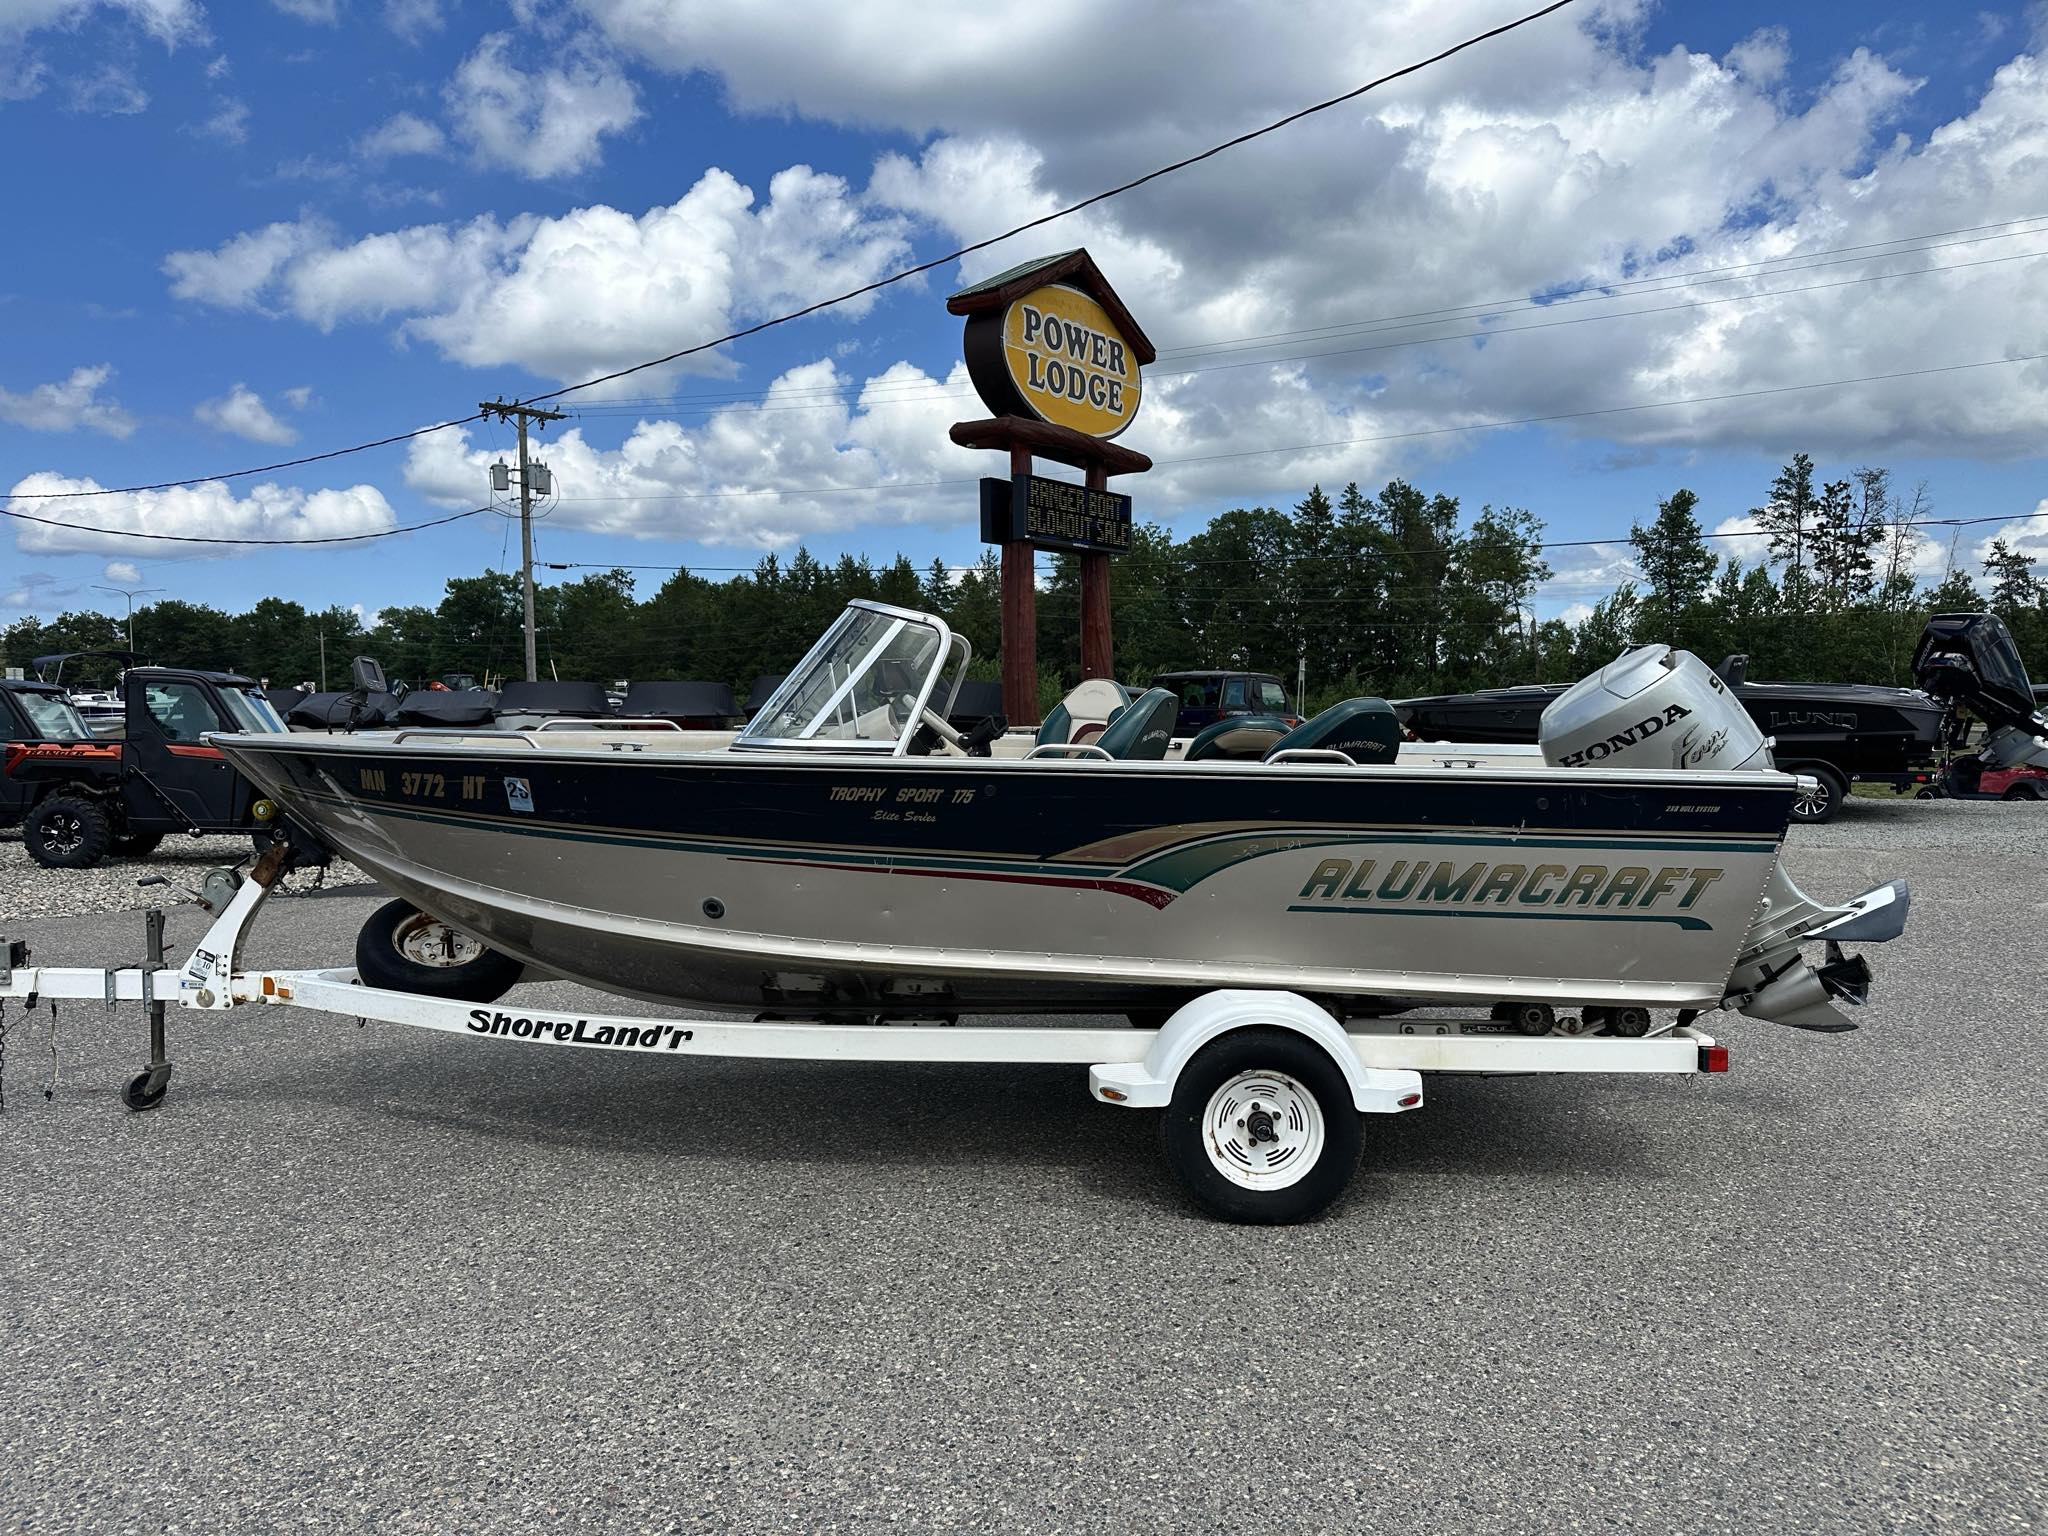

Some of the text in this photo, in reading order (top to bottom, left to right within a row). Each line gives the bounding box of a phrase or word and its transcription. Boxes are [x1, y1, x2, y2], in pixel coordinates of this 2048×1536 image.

[1023, 307, 1126, 375] POWER
[1027, 353, 1124, 413] LODGE
[1030, 479, 1123, 521] RANGER BOAT
[1027, 506, 1130, 546] BLOWOUT SALE
[1559, 703, 1692, 767] HONDA
[1770, 711, 1858, 730] LUND
[1326, 740, 1387, 753] ALUMACRAFT
[360, 769, 486, 800] MN 3772 HT
[829, 786, 976, 804] TROPHY SPORT 175
[871, 810, 937, 822] Elite Series
[1695, 805, 1721, 813] SYSTEM
[1298, 858, 1726, 909] ALUMACRAFT
[467, 1009, 694, 1049] ShoreLand'r
